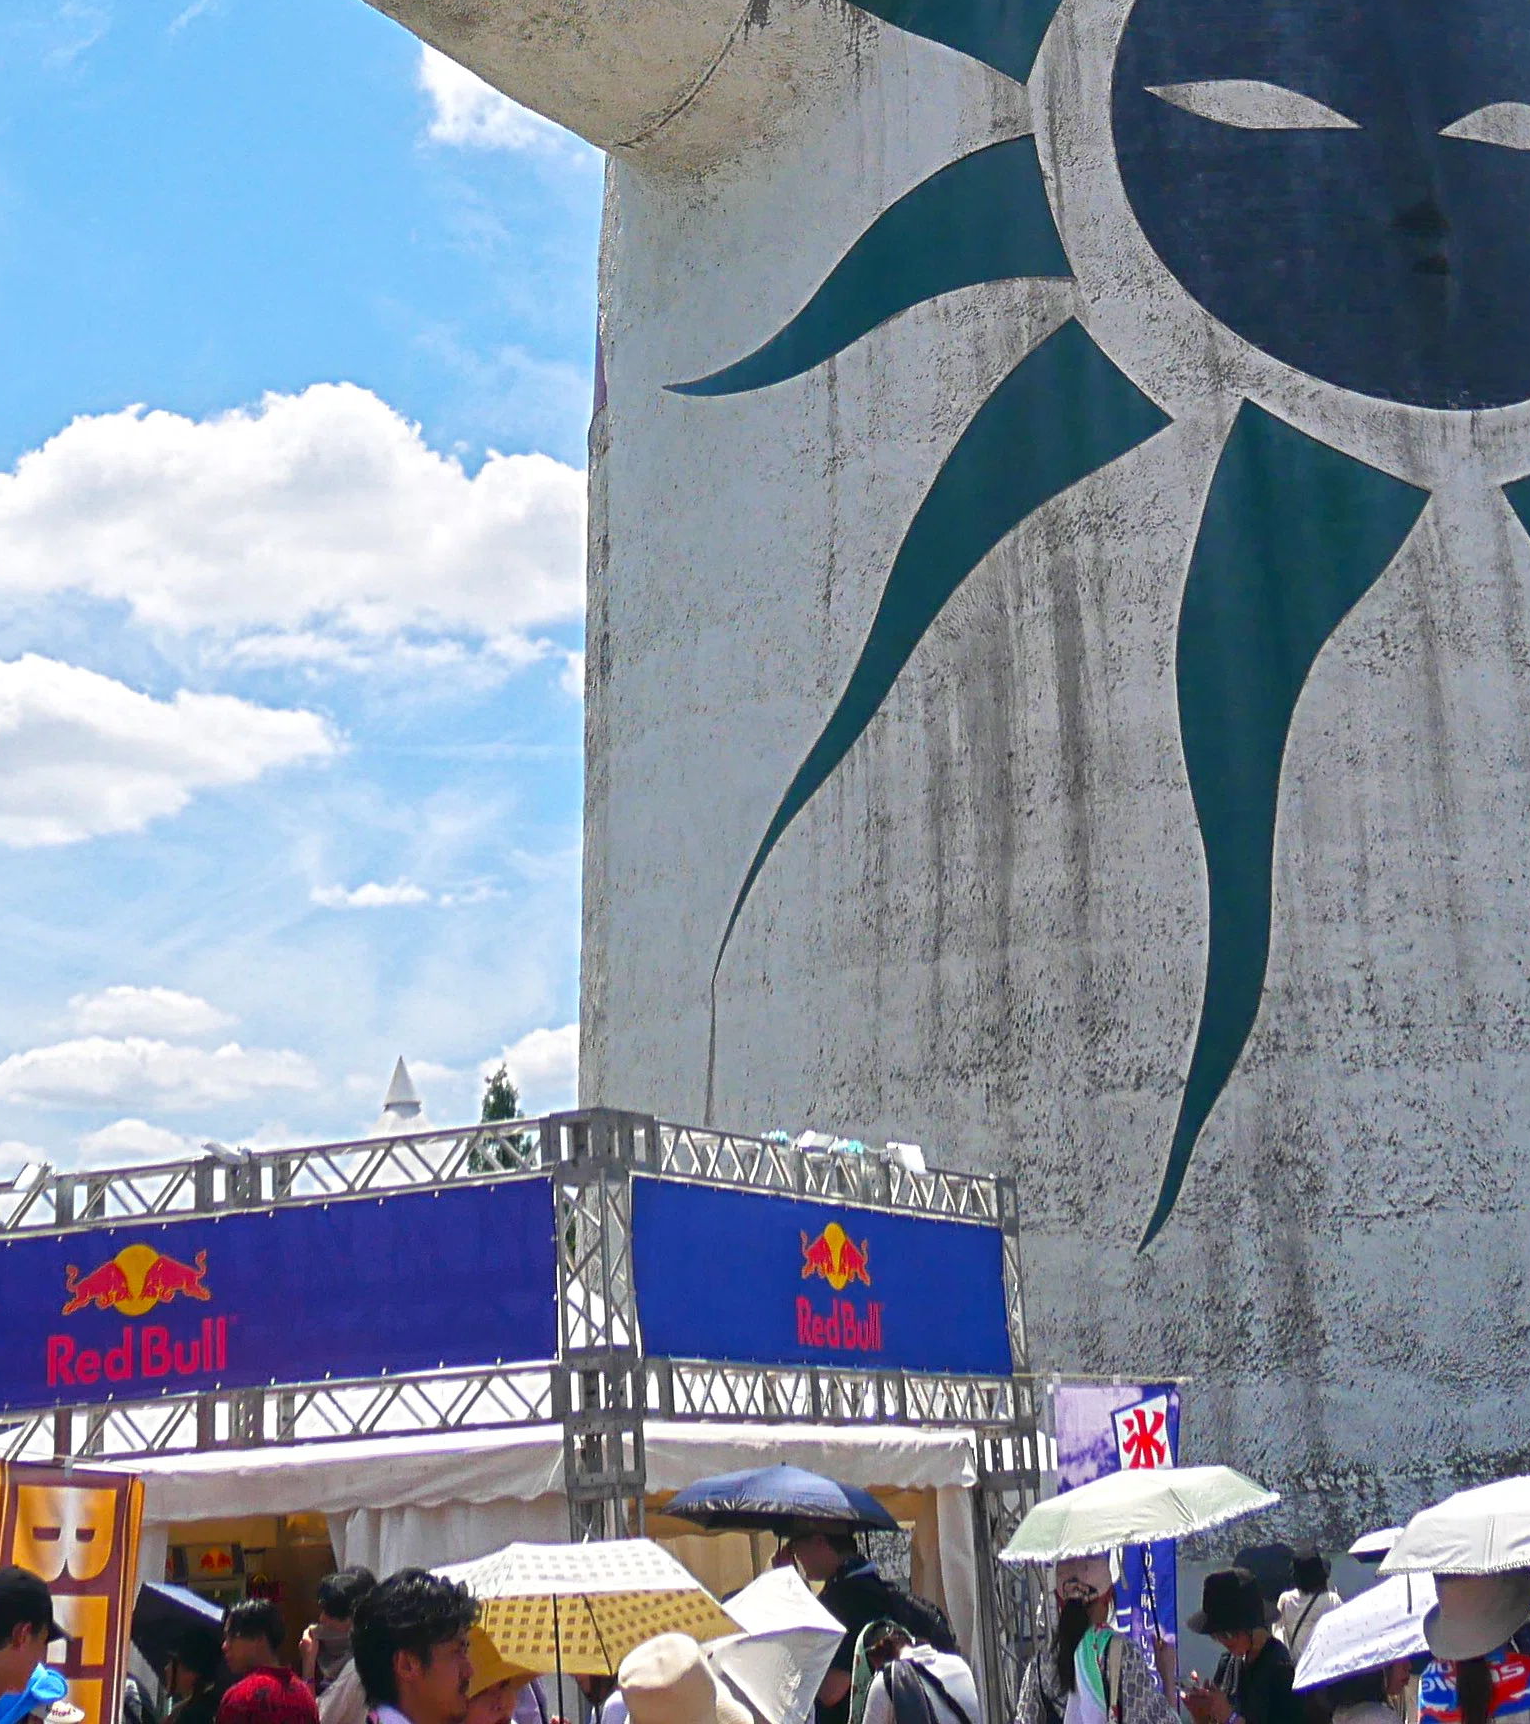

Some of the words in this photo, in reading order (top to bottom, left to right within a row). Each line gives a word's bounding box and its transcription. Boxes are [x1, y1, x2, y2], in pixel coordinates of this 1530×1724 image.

[48, 1326, 134, 1387] Red
[142, 1317, 227, 1377] Bull
[795, 1295, 839, 1349] Red
[842, 1300, 882, 1351] Bull
[1122, 1409, 1167, 1470] 氷
